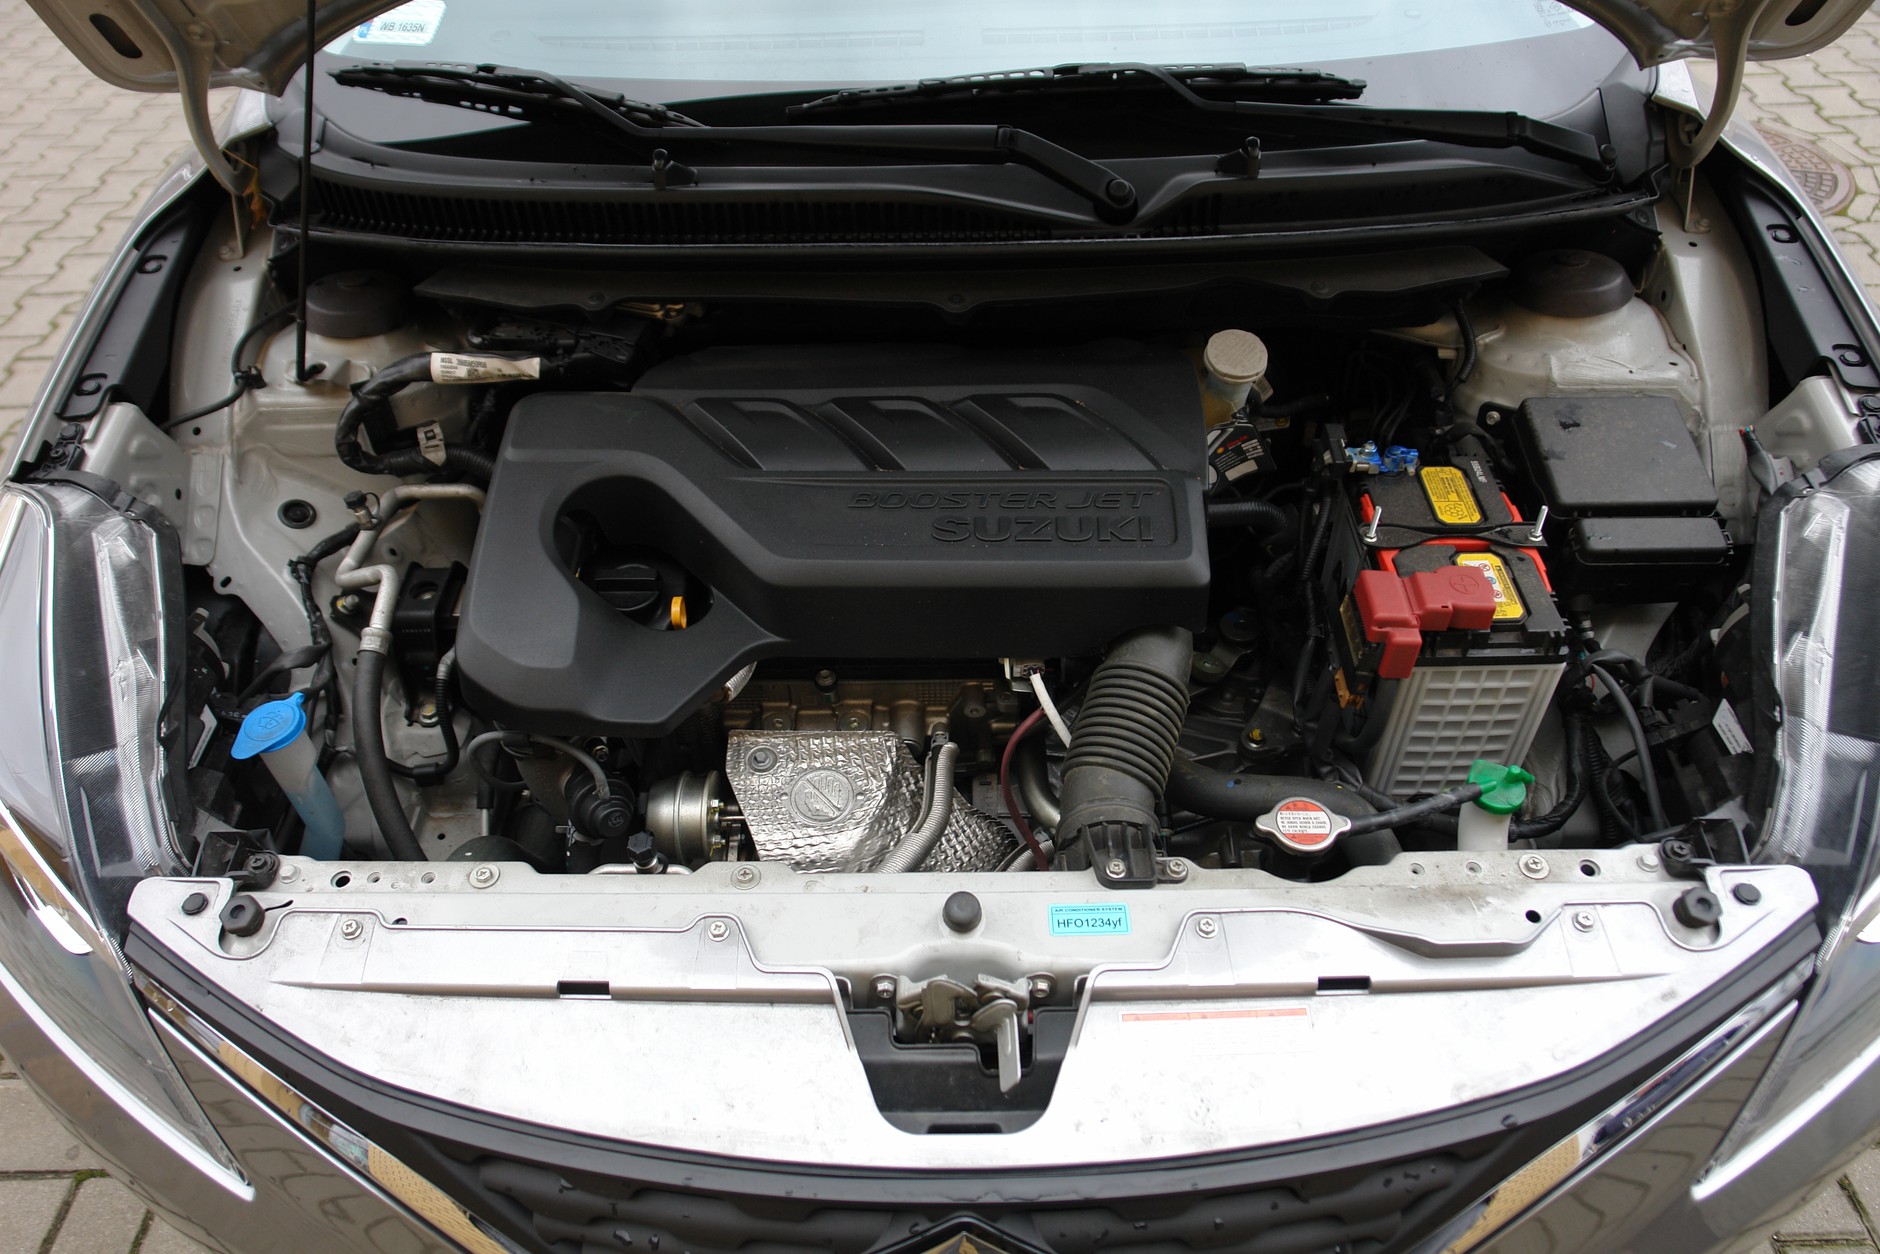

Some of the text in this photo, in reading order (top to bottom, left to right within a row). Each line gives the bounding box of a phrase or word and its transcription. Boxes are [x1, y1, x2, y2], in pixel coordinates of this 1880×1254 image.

[398, 23, 425, 32] 1635N
[849, 491, 1154, 509] BOOSTER JET
[931, 515, 1155, 542] SUZUKI
[1057, 917, 1122, 929] HFO1234yf
